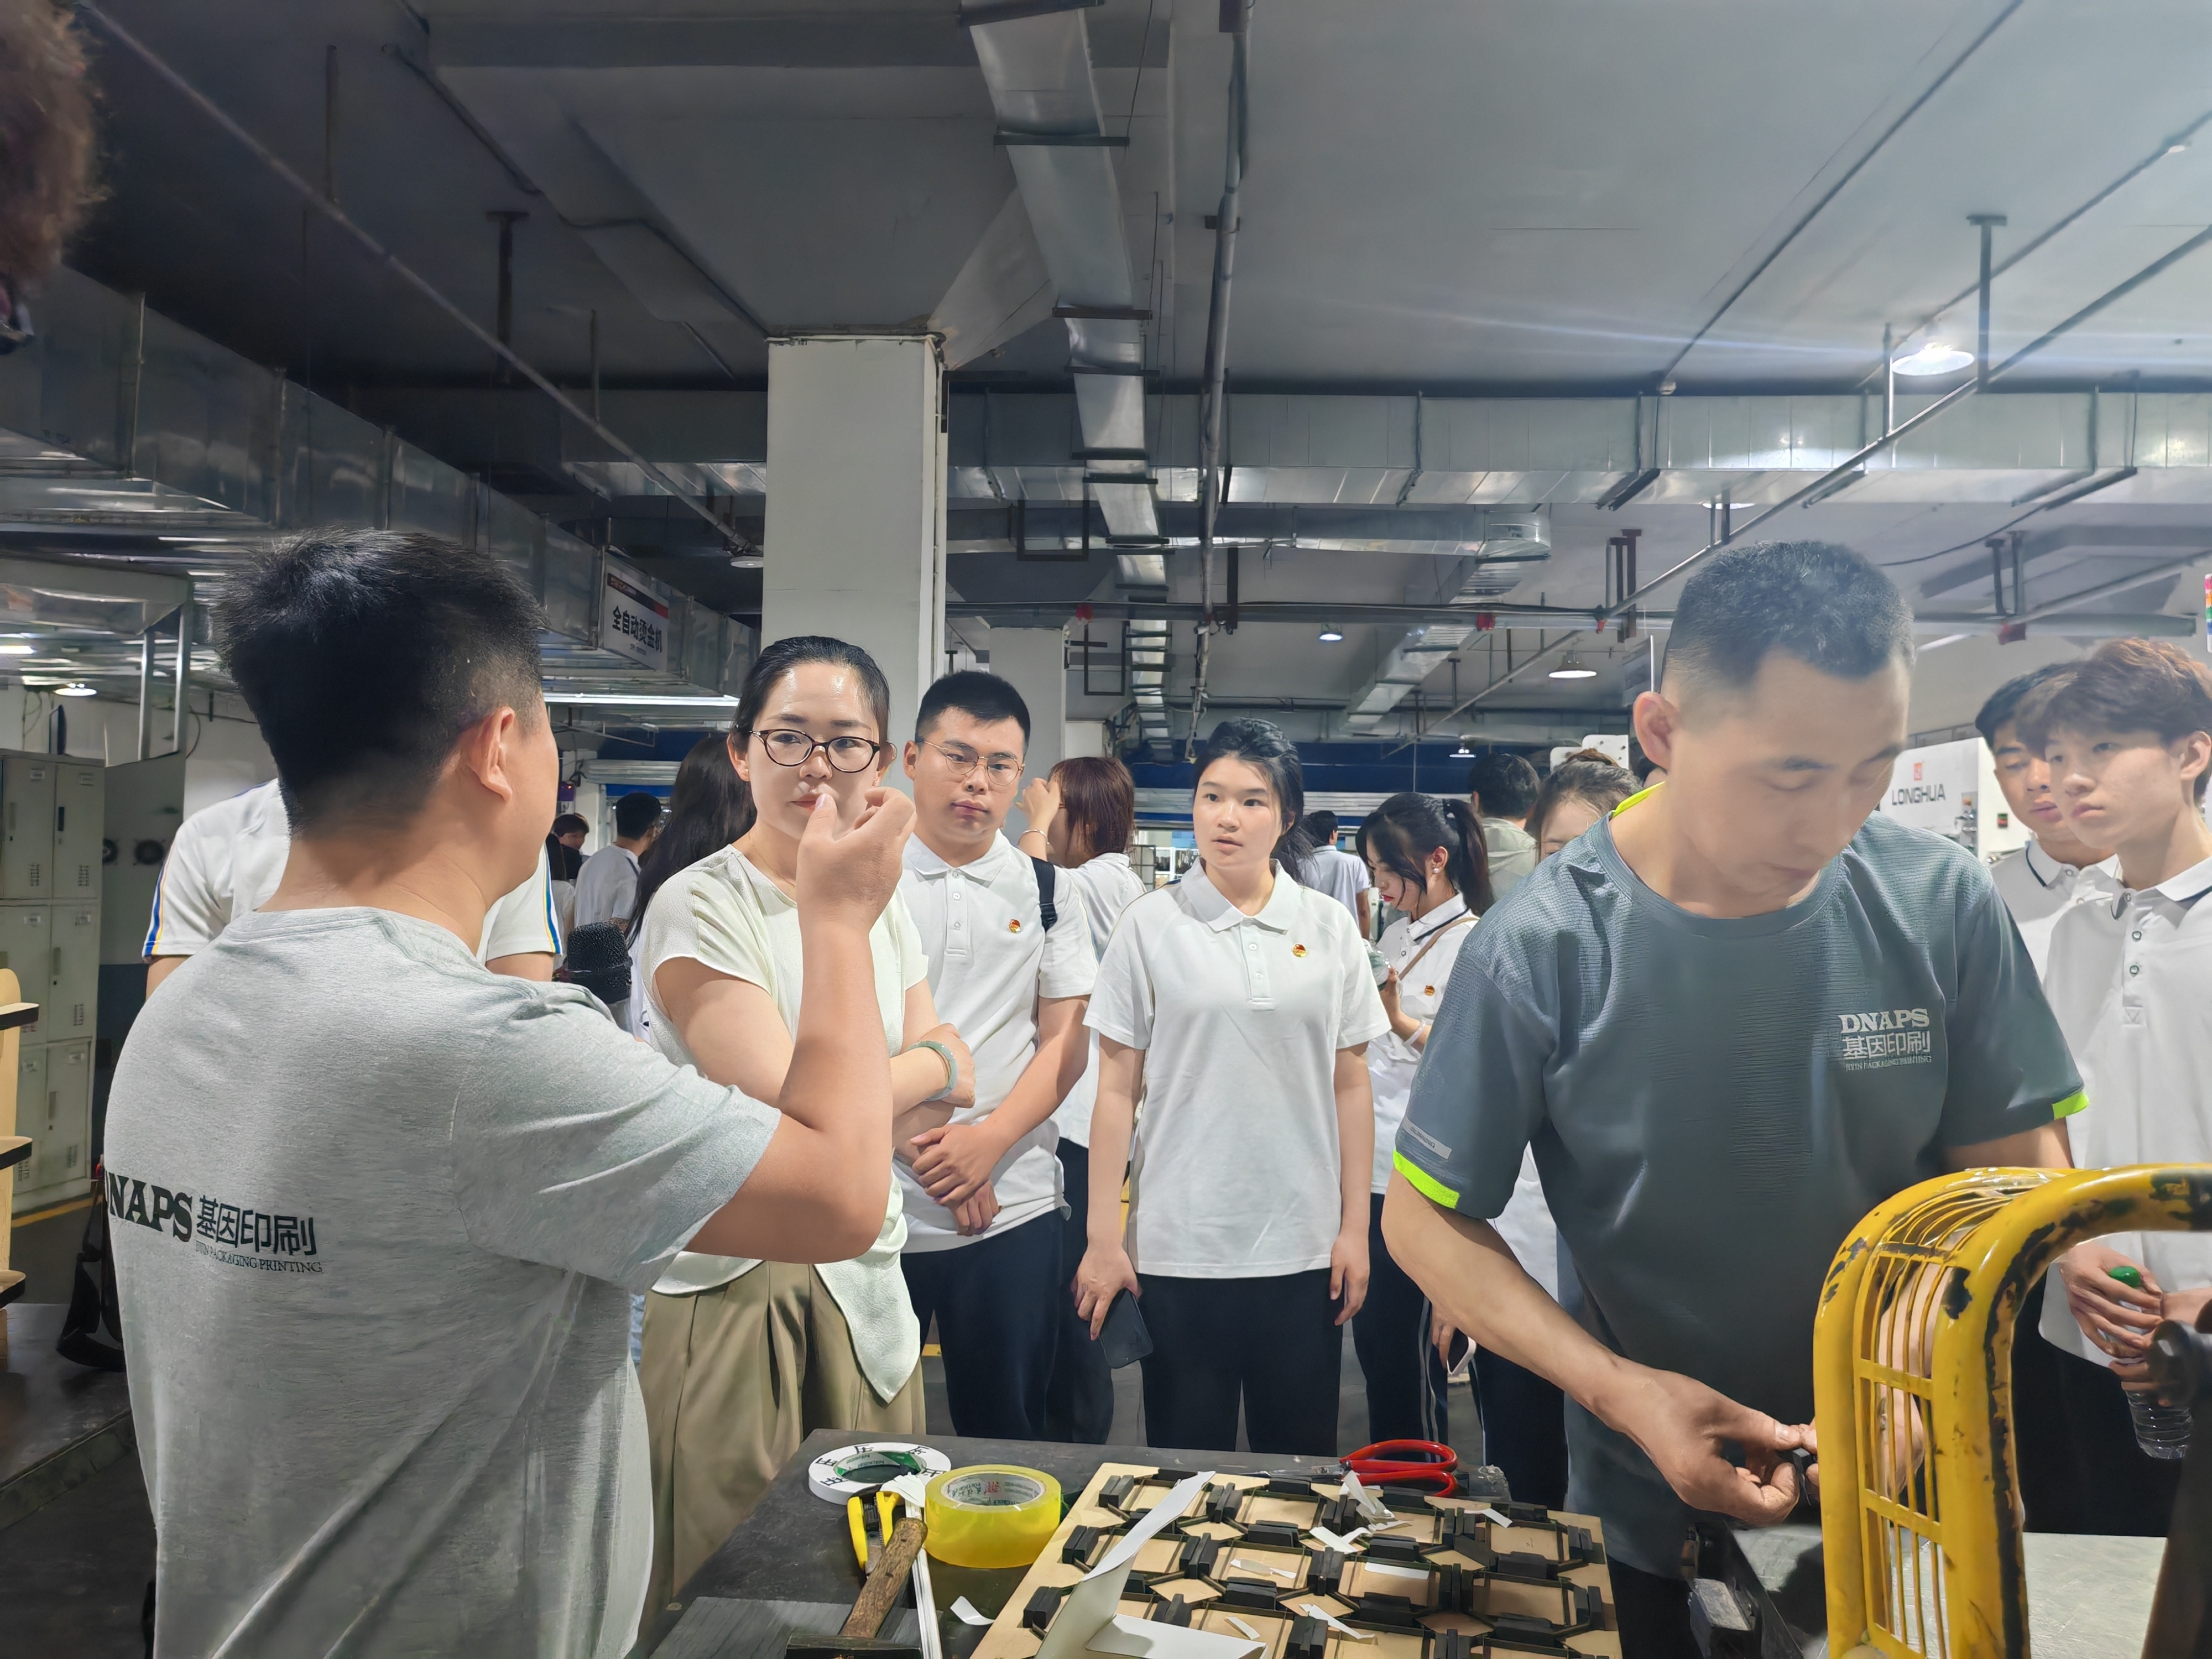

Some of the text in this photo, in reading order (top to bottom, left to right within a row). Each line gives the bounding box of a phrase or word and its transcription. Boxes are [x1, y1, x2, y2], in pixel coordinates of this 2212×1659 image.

[1892, 783, 1945, 806] LONGHUA
[1838, 1008, 1930, 1034] DNAPS
[1842, 1031, 1931, 1060] 基因印刷
[106, 1170, 193, 1243] NAPS
[196, 1194, 317, 1256] 基因印刷
[259, 1259, 323, 1273] PRINTING
